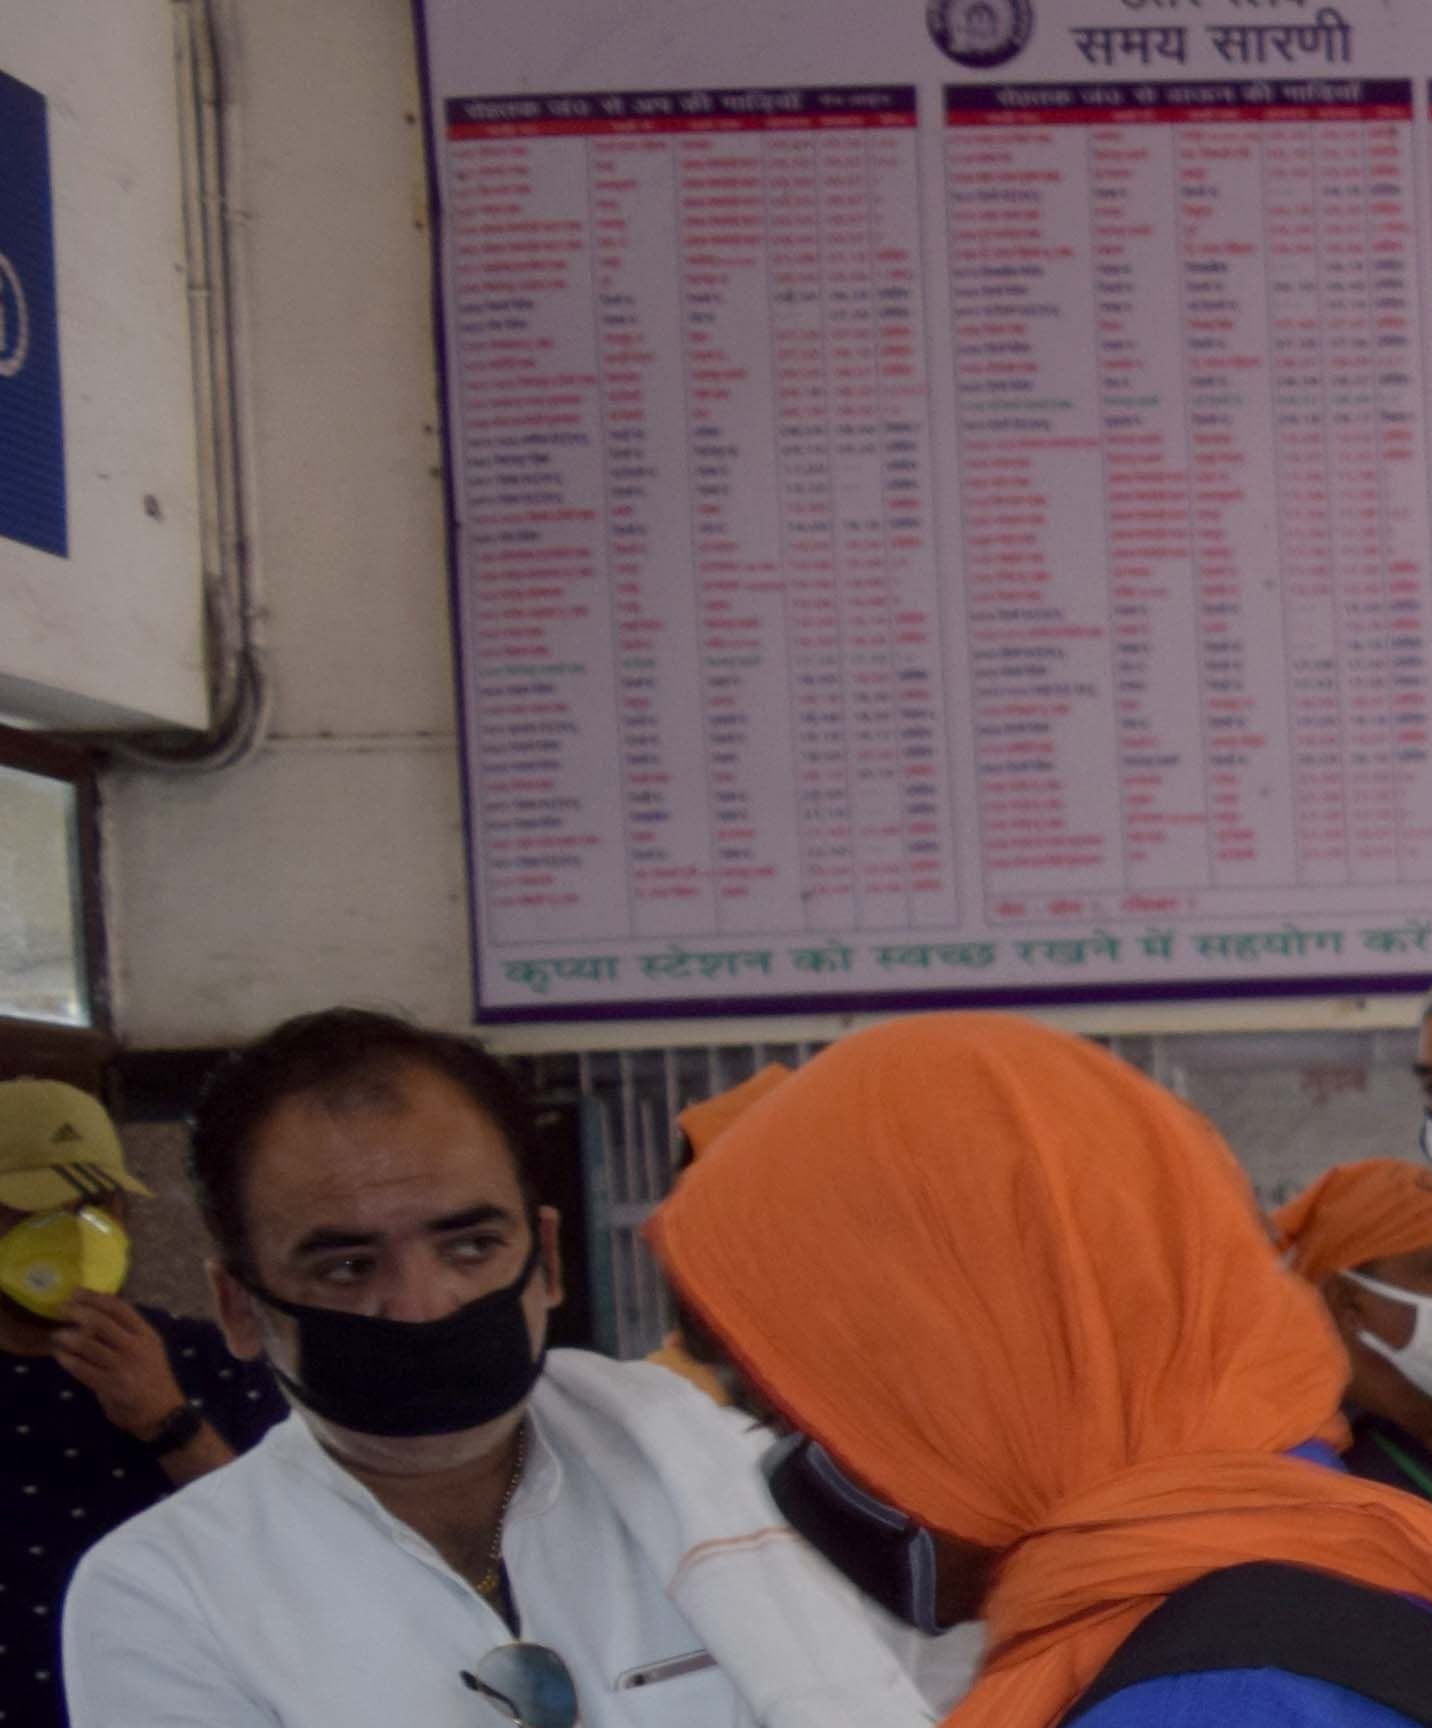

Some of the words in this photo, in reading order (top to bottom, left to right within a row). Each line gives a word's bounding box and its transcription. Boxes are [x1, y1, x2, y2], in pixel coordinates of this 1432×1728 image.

[1070, 25, 1188, 65] समय
[1206, 7, 1353, 64] सारणी
[636, 944, 772, 982] स्टेशन
[793, 939, 854, 974] को
[1014, 929, 1120, 966] रखने
[1136, 926, 1177, 961] में
[1191, 922, 1343, 961] सहयोग
